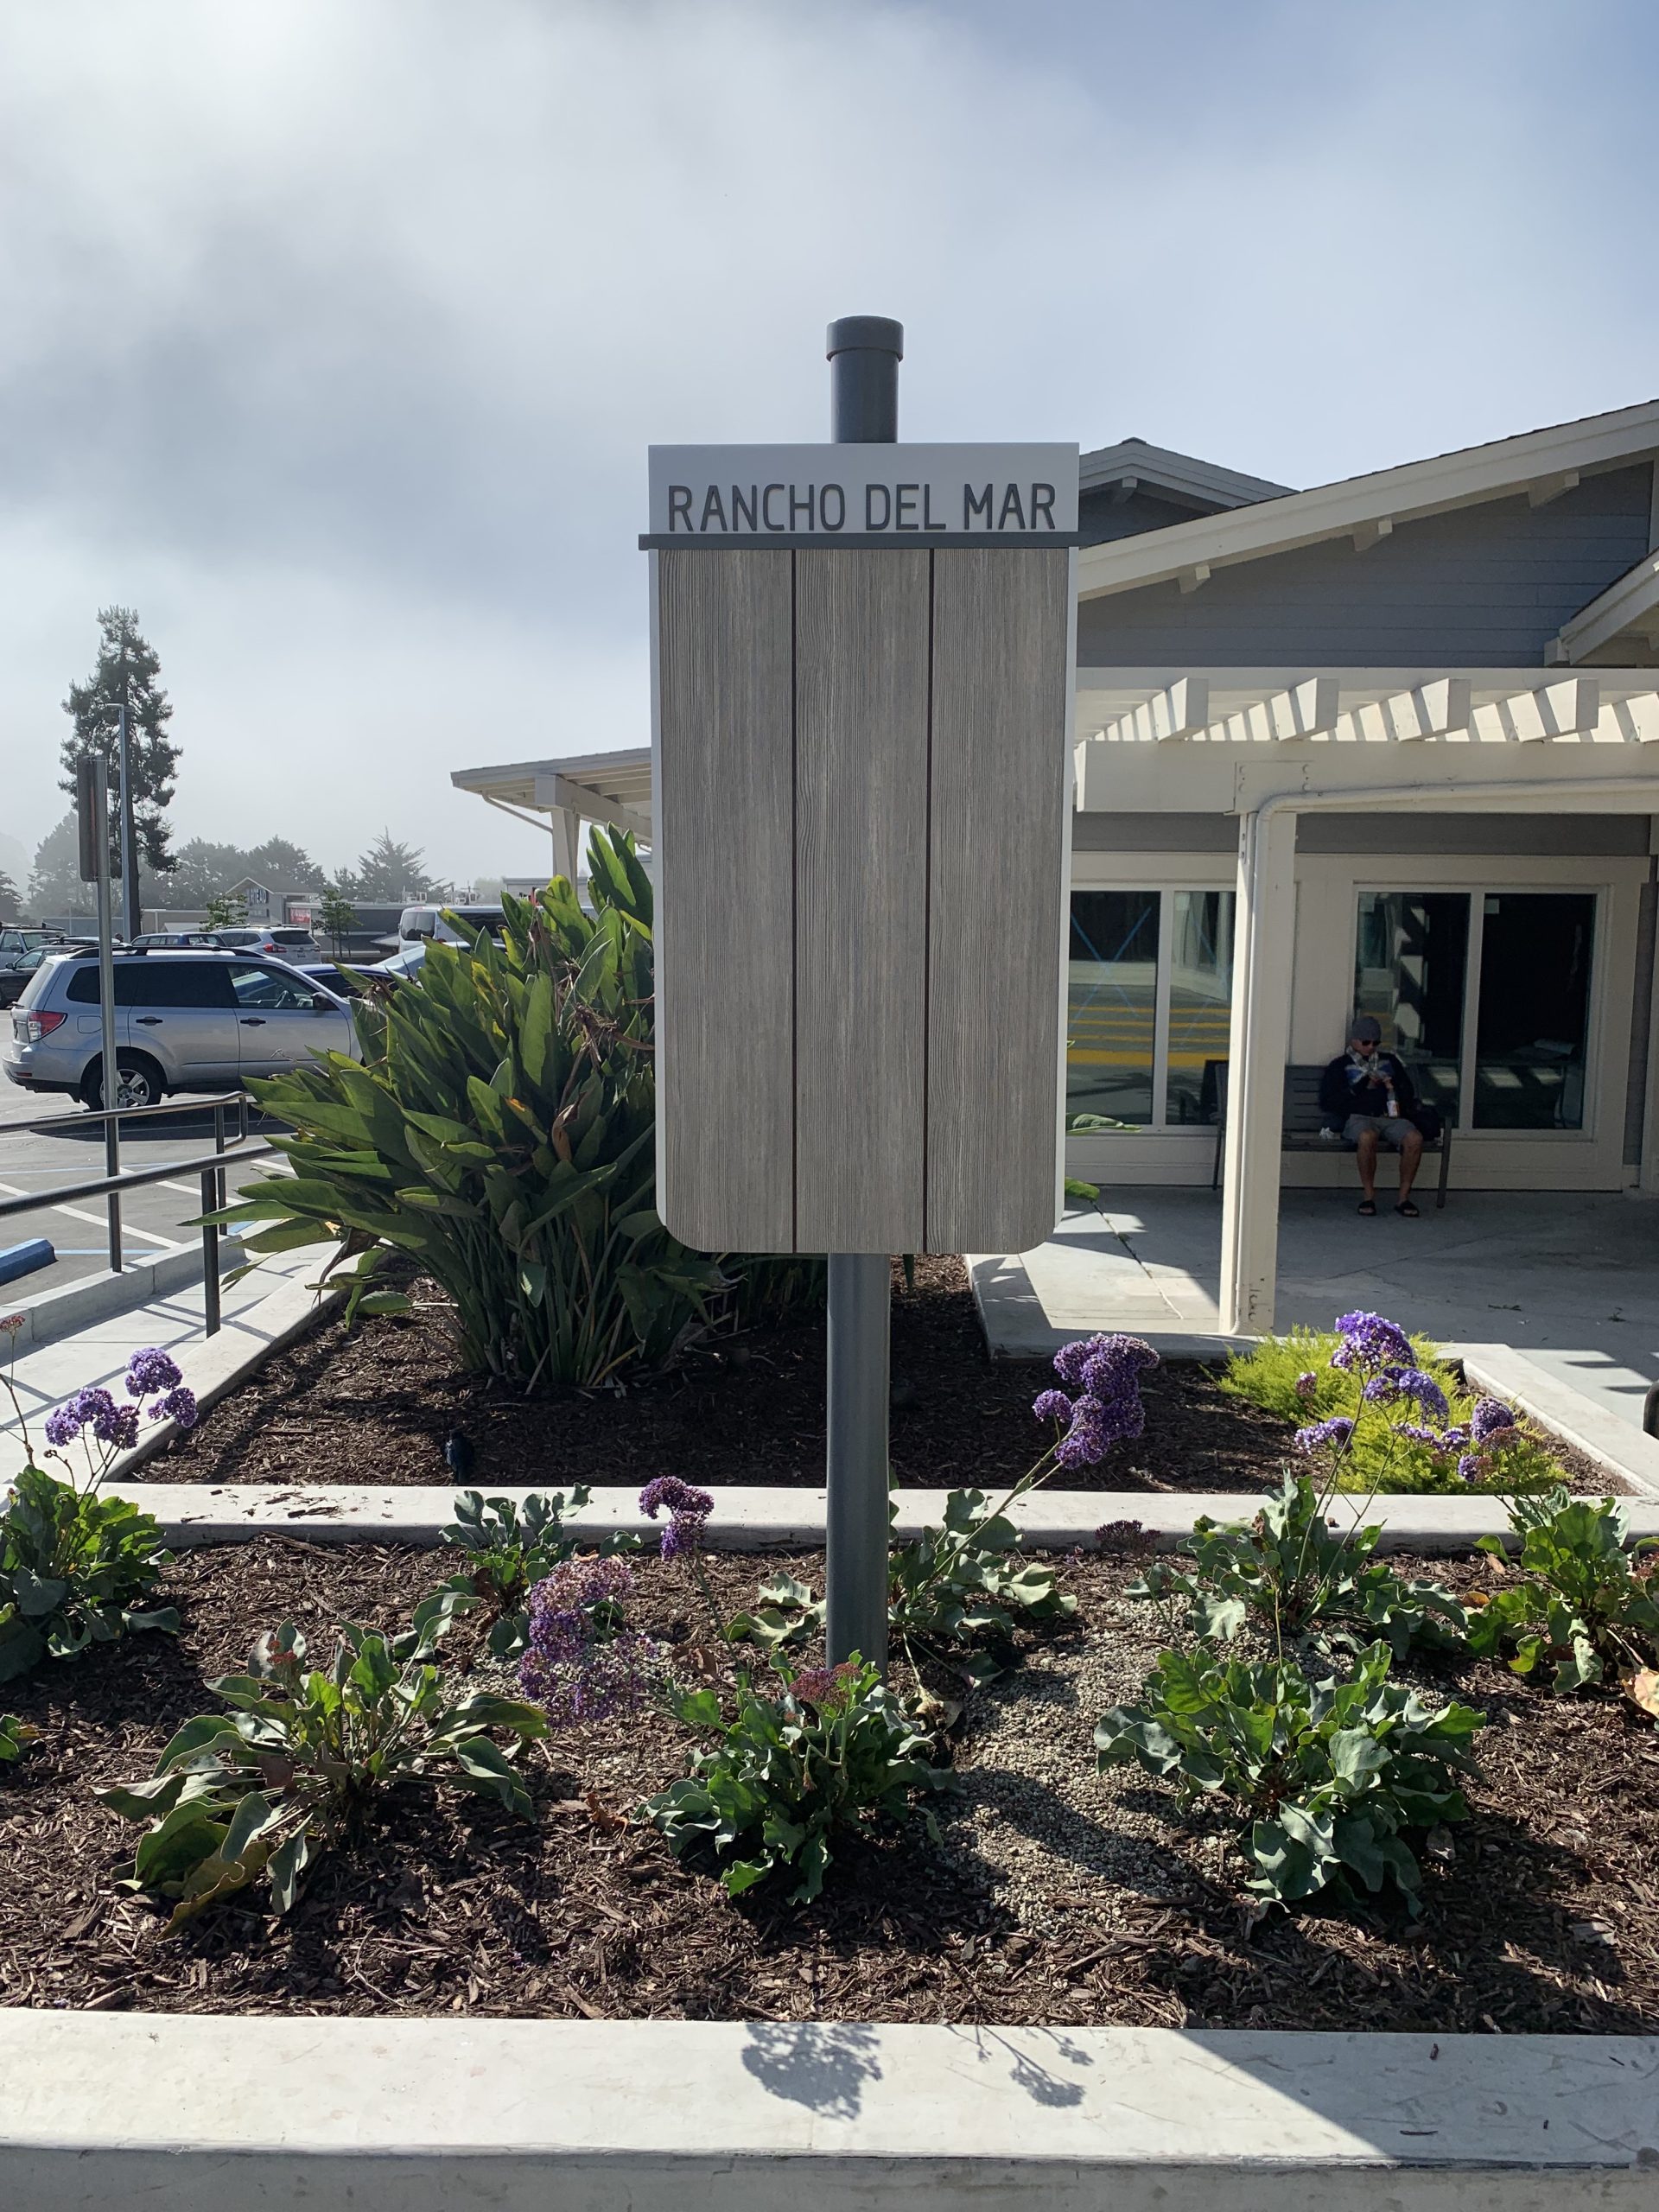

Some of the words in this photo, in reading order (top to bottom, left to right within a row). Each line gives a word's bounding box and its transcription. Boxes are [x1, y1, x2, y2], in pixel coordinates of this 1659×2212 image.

[668, 484, 846, 532] RANCHO
[865, 484, 947, 531] DEL
[963, 483, 1057, 531] MAR
